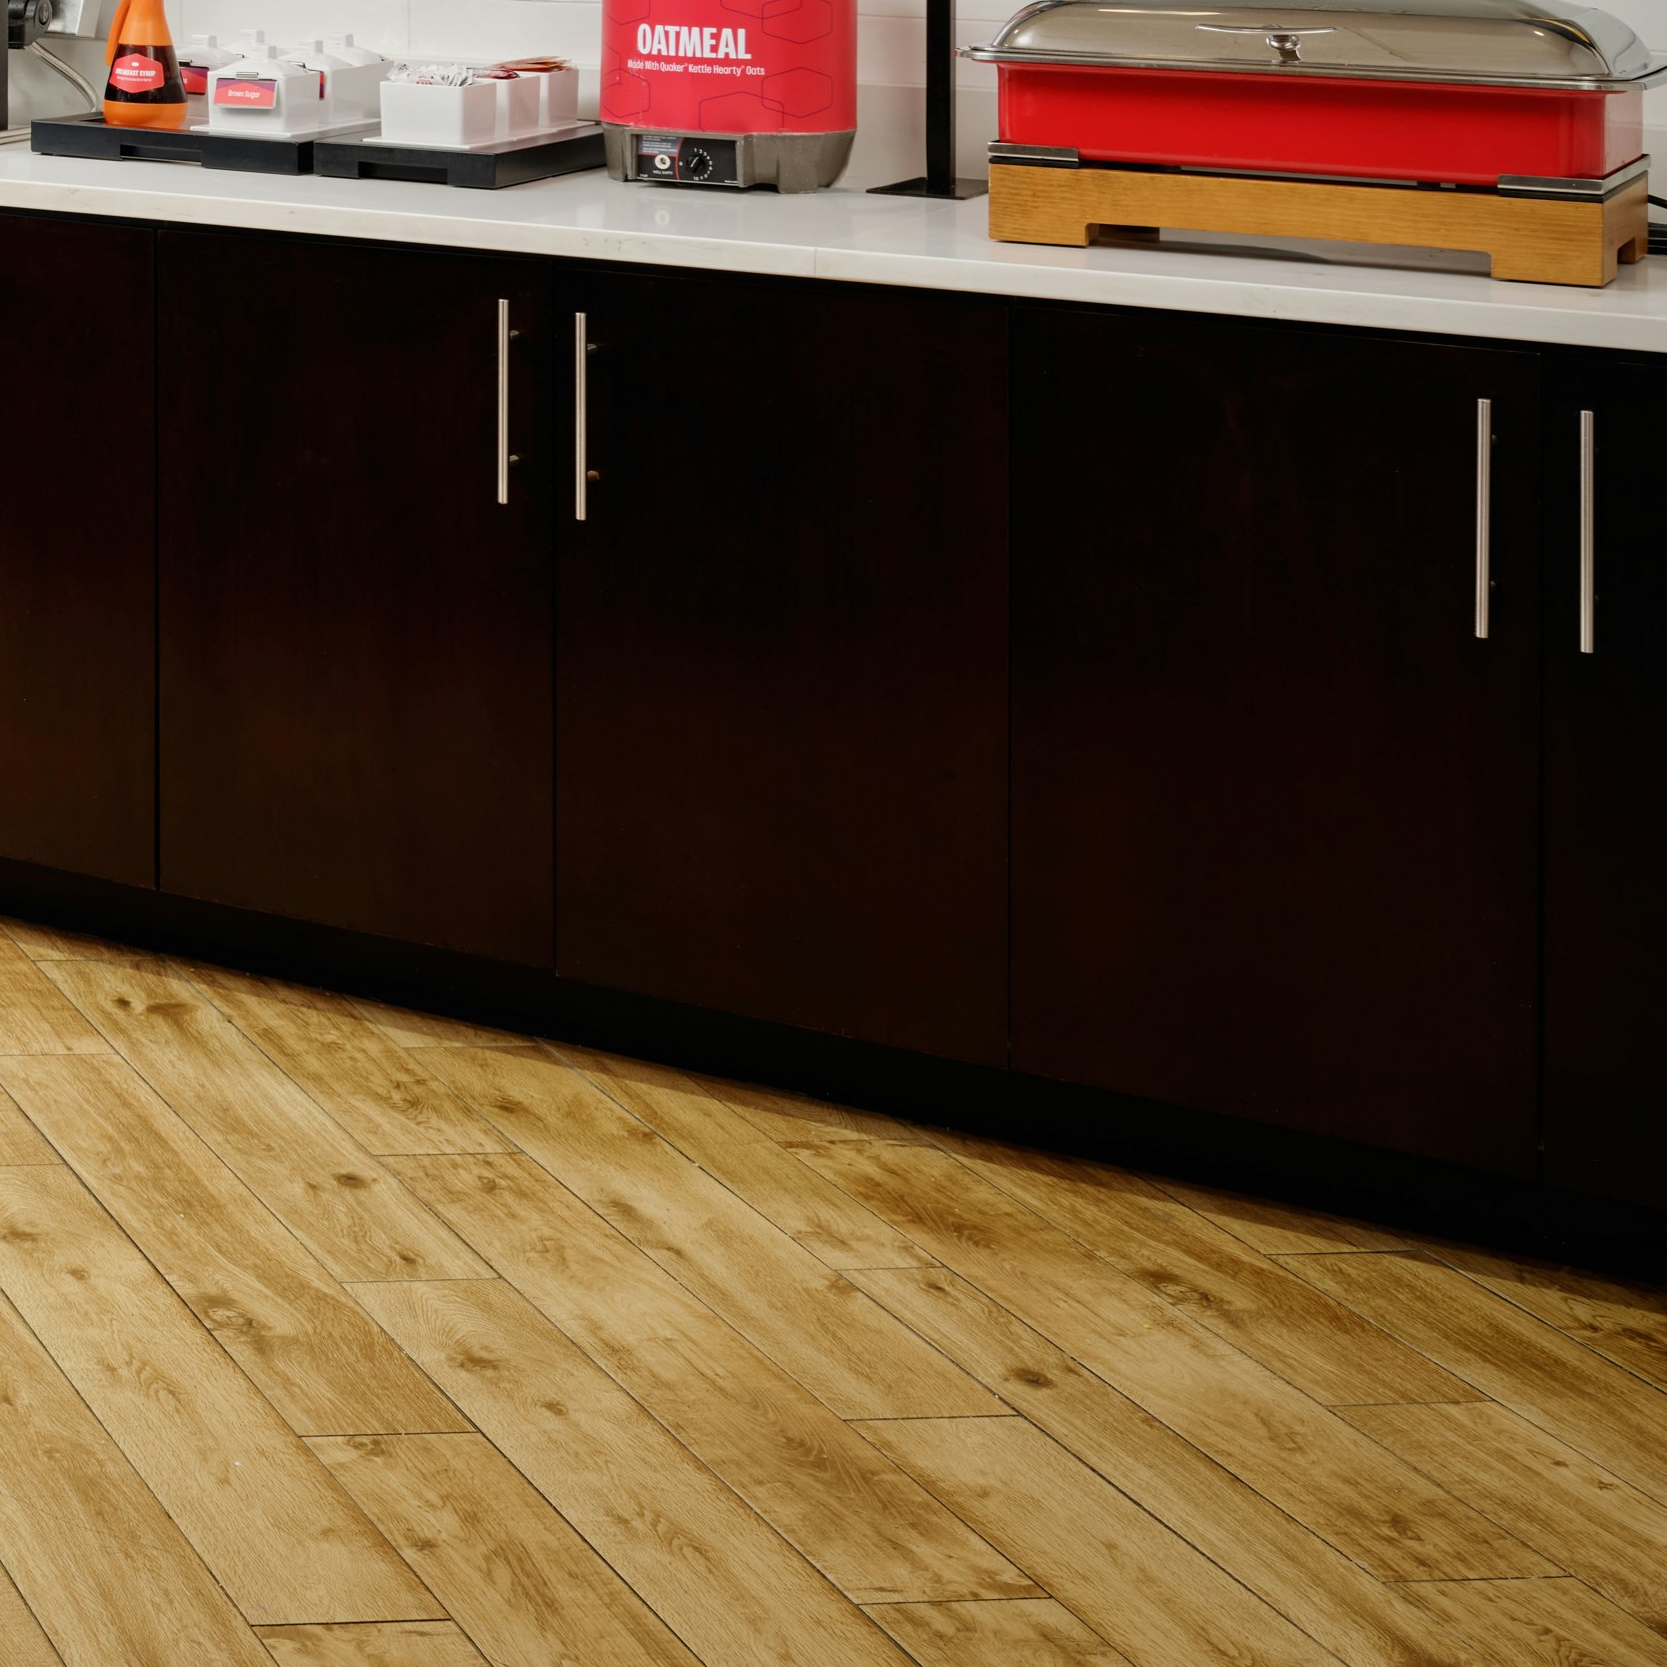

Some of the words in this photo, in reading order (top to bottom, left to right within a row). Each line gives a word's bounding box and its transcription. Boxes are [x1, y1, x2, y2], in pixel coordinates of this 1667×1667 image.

[637, 23, 752, 59] OATMEAL
[627, 59, 643, 69] Made
[644, 60, 659, 71] With
[659, 62, 685, 72] Quaker
[688, 64, 712, 74] Kettle
[713, 65, 741, 77] Hearty
[746, 65, 765, 76] Oats
[227, 89, 244, 98] Brown
[244, 90, 261, 99] Sugar
